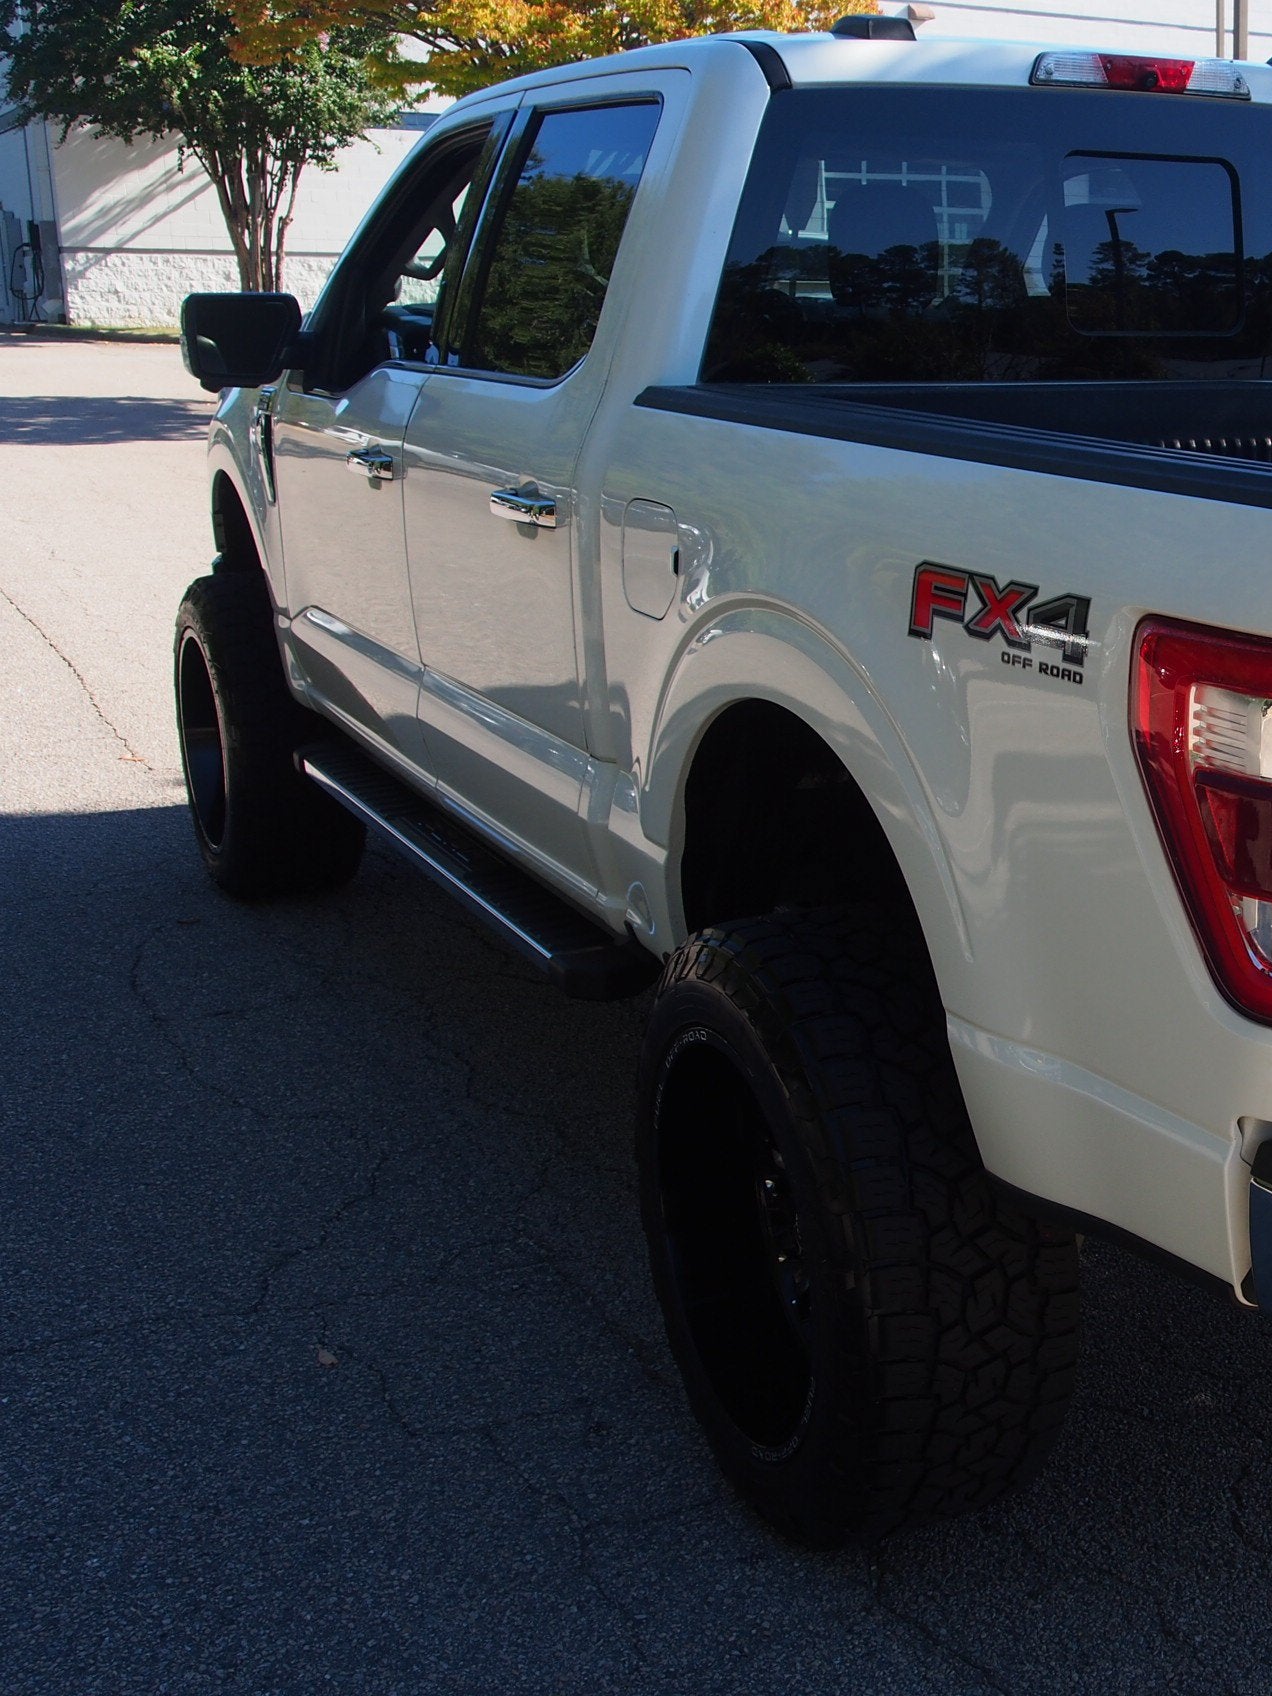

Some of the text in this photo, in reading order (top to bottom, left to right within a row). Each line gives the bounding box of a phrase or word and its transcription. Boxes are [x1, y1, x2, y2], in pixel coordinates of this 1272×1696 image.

[908, 559, 1093, 668] FX4
[1001, 650, 1084, 685] OFF ROAD
